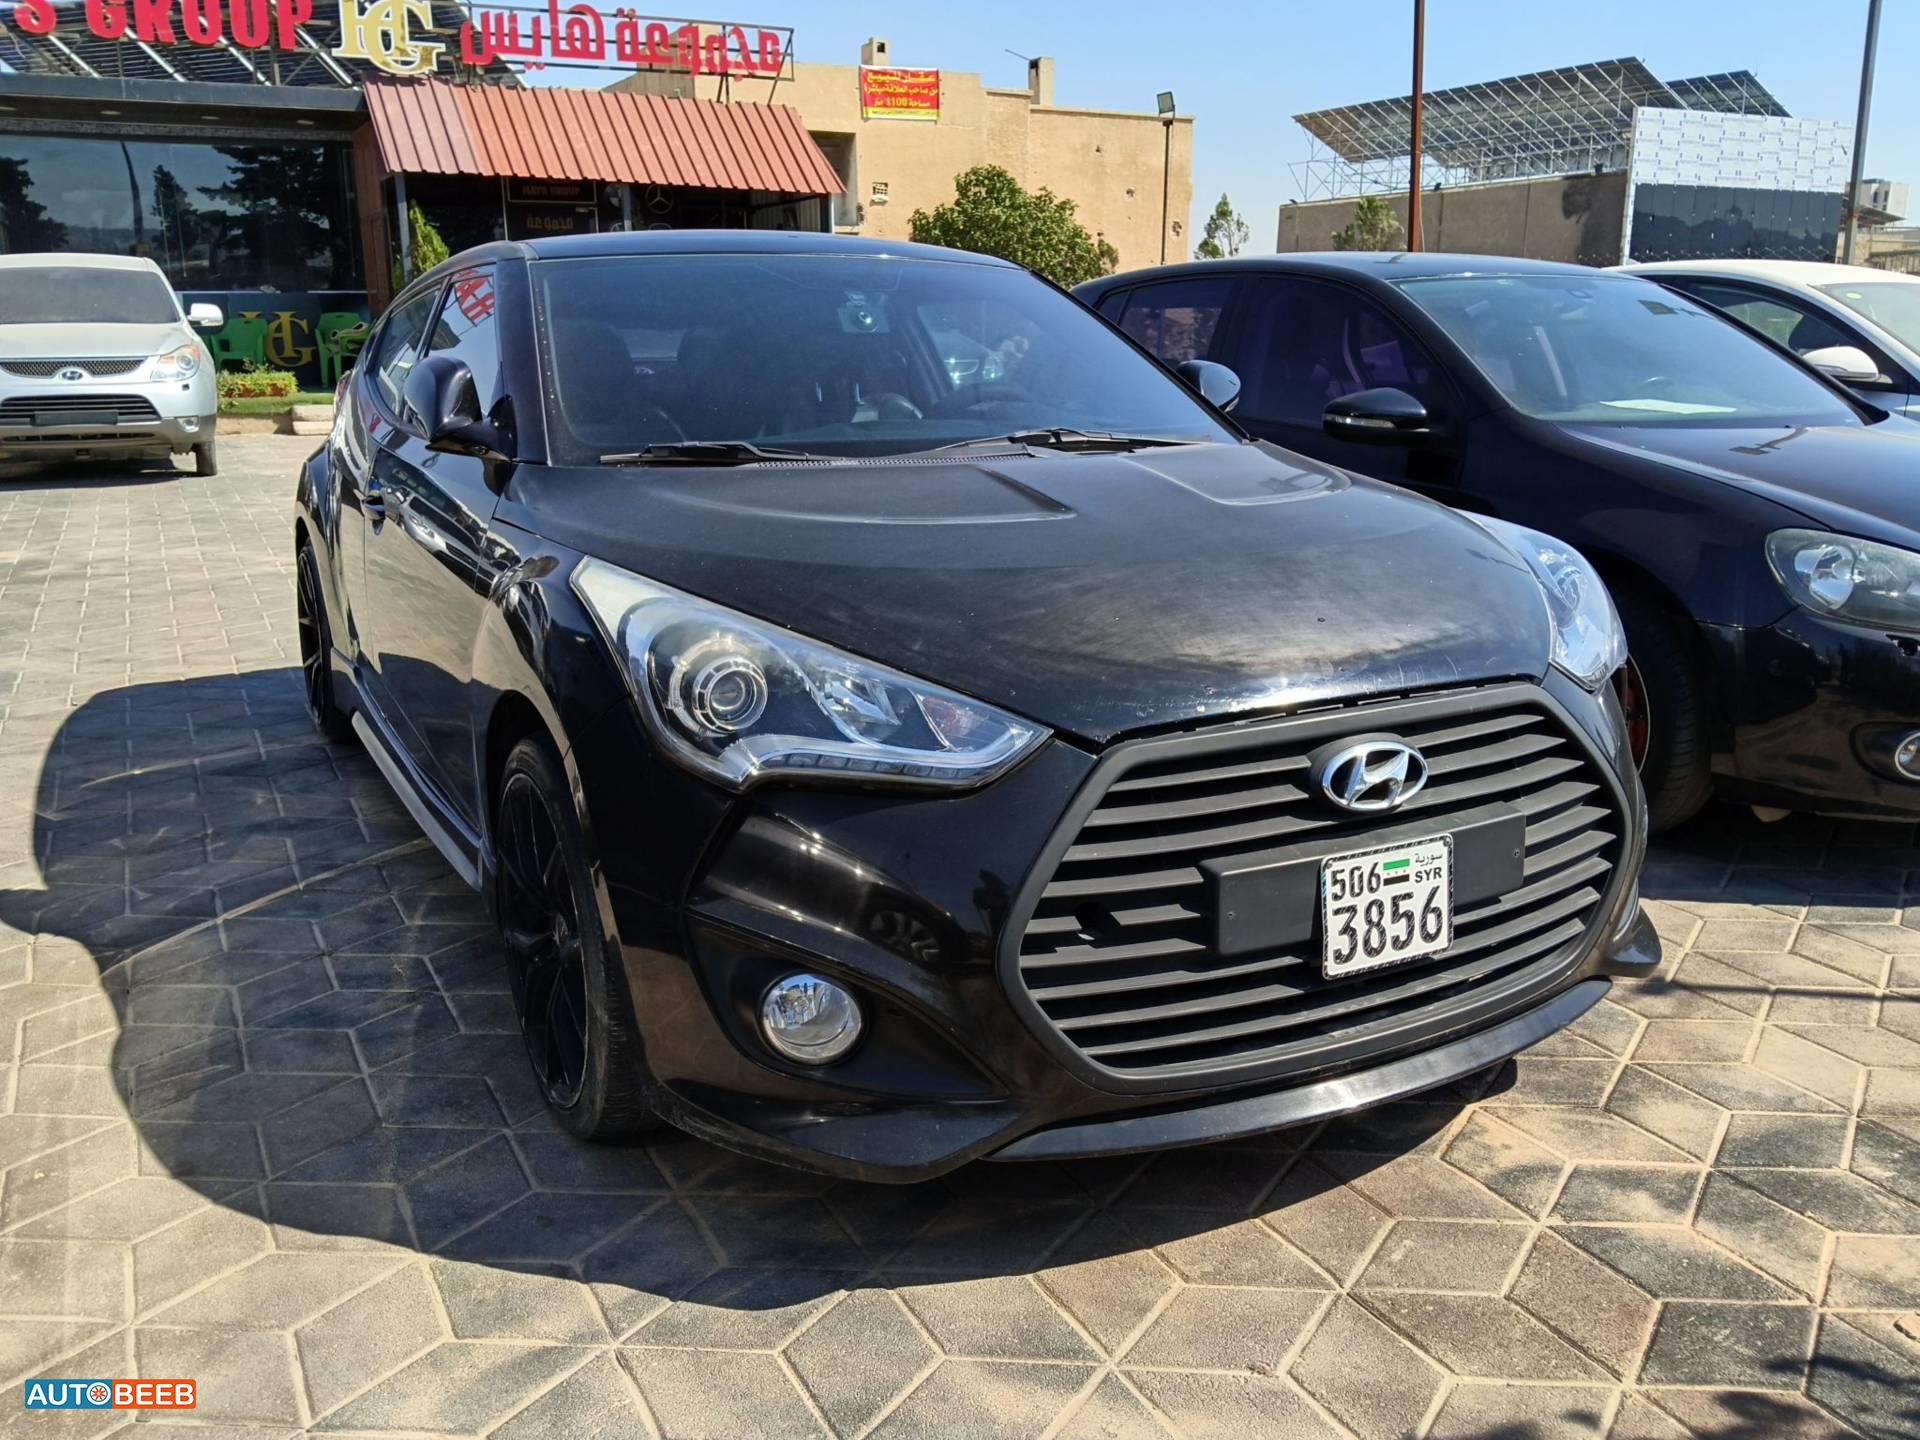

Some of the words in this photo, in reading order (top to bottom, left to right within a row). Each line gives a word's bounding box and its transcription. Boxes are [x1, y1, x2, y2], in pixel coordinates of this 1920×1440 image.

[85, 0, 312, 51] GROUP
[616, 8, 781, 81] مجموعة
[886, 96, 908, 107] 1100
[1414, 852, 1443, 867] سورية
[1414, 867, 1442, 883] SYR
[1331, 861, 1381, 901] 506
[1332, 885, 1443, 965] 3856
